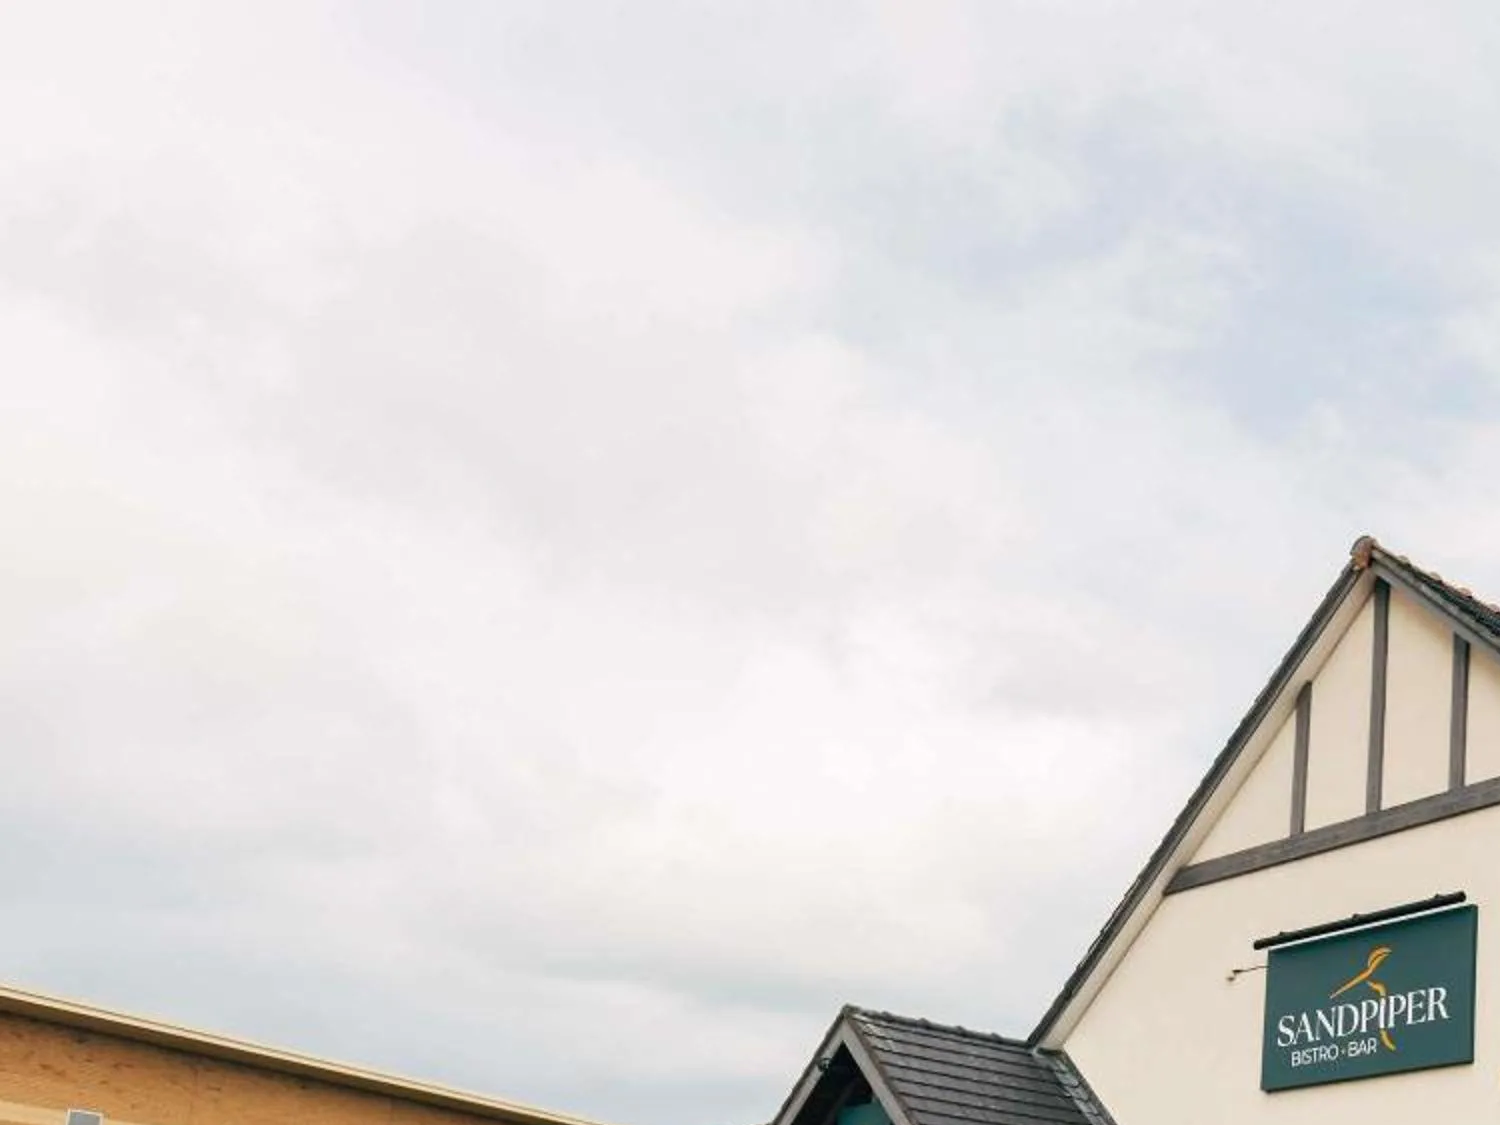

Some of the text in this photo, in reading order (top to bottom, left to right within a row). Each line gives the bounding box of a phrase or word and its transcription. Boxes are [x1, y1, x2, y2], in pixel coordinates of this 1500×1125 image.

[1276, 986, 1450, 1048] SANDPIPER
[1290, 1037, 1378, 1067] BISTRO BAR
